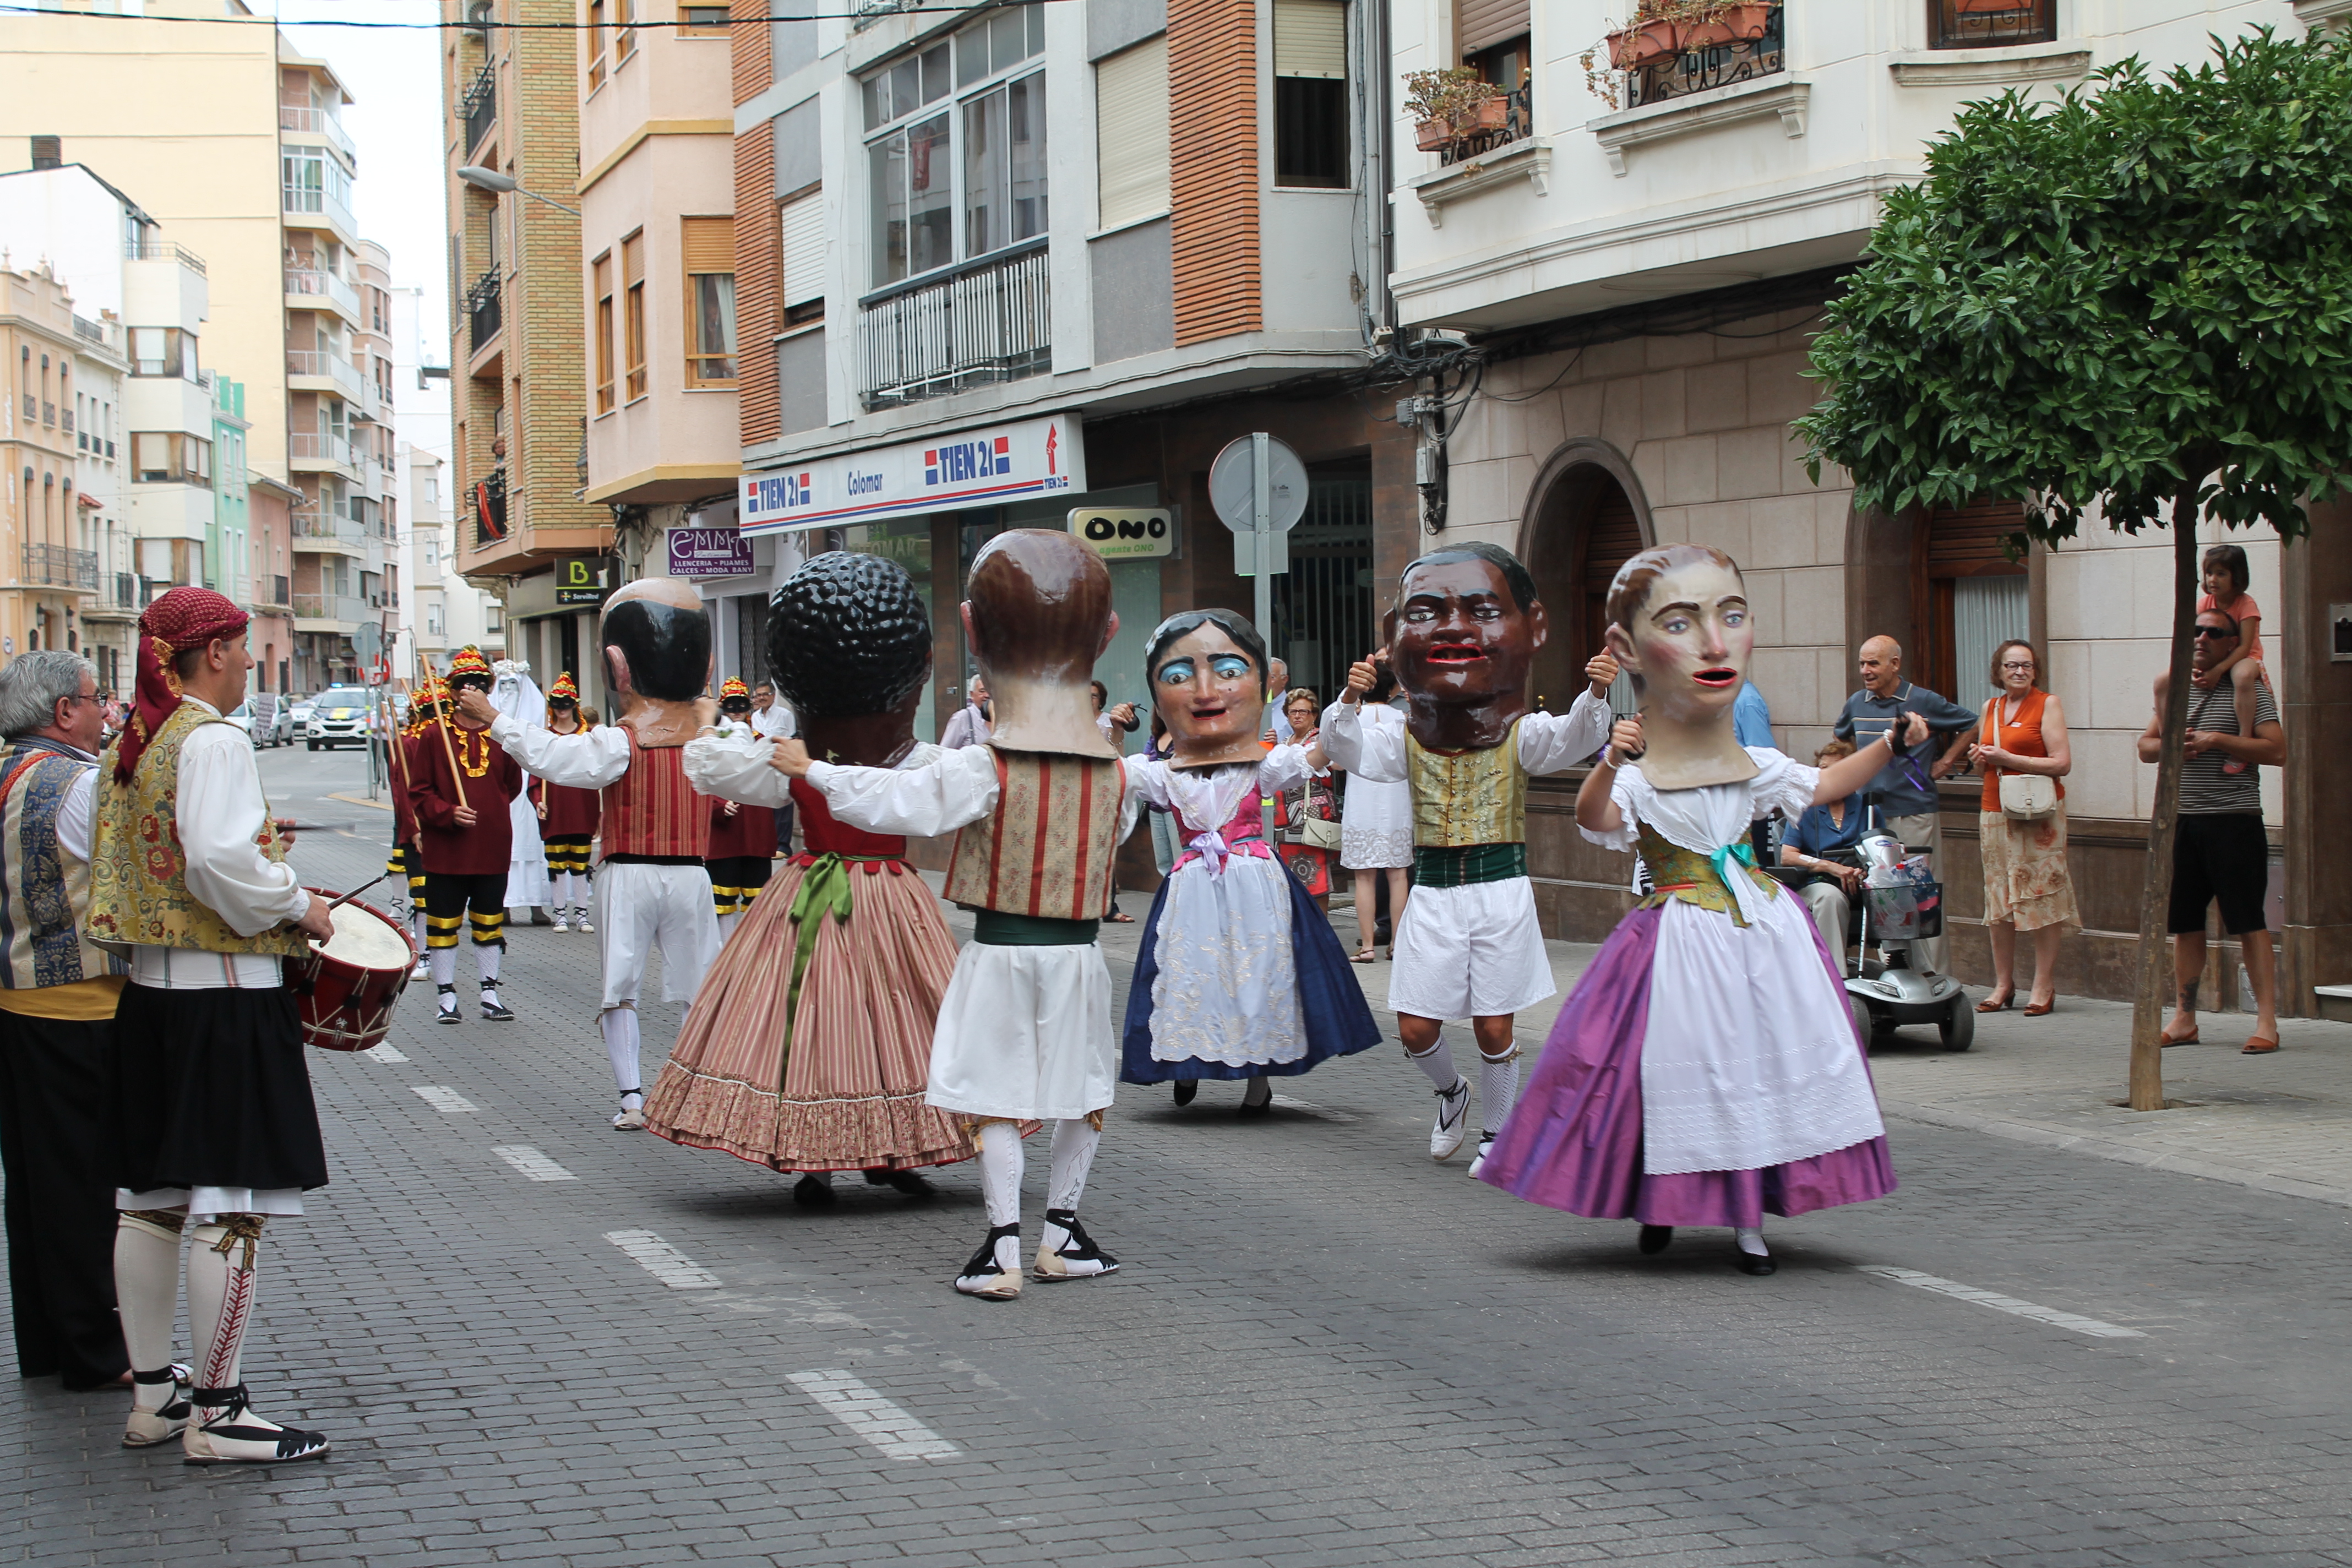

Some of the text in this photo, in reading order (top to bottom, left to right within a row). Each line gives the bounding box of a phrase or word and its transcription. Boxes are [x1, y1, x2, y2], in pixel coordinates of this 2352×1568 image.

[939, 440, 993, 483] TIEN 21
[759, 475, 799, 511] TIEN 21
[848, 470, 882, 496] Colomar
[1044, 477, 1062, 489] TIEN 21
[1085, 517, 1166, 540] ONO
[671, 530, 752, 559] EMMA
[1099, 544, 1154, 555] agente ONO
[570, 562, 589, 584] B
